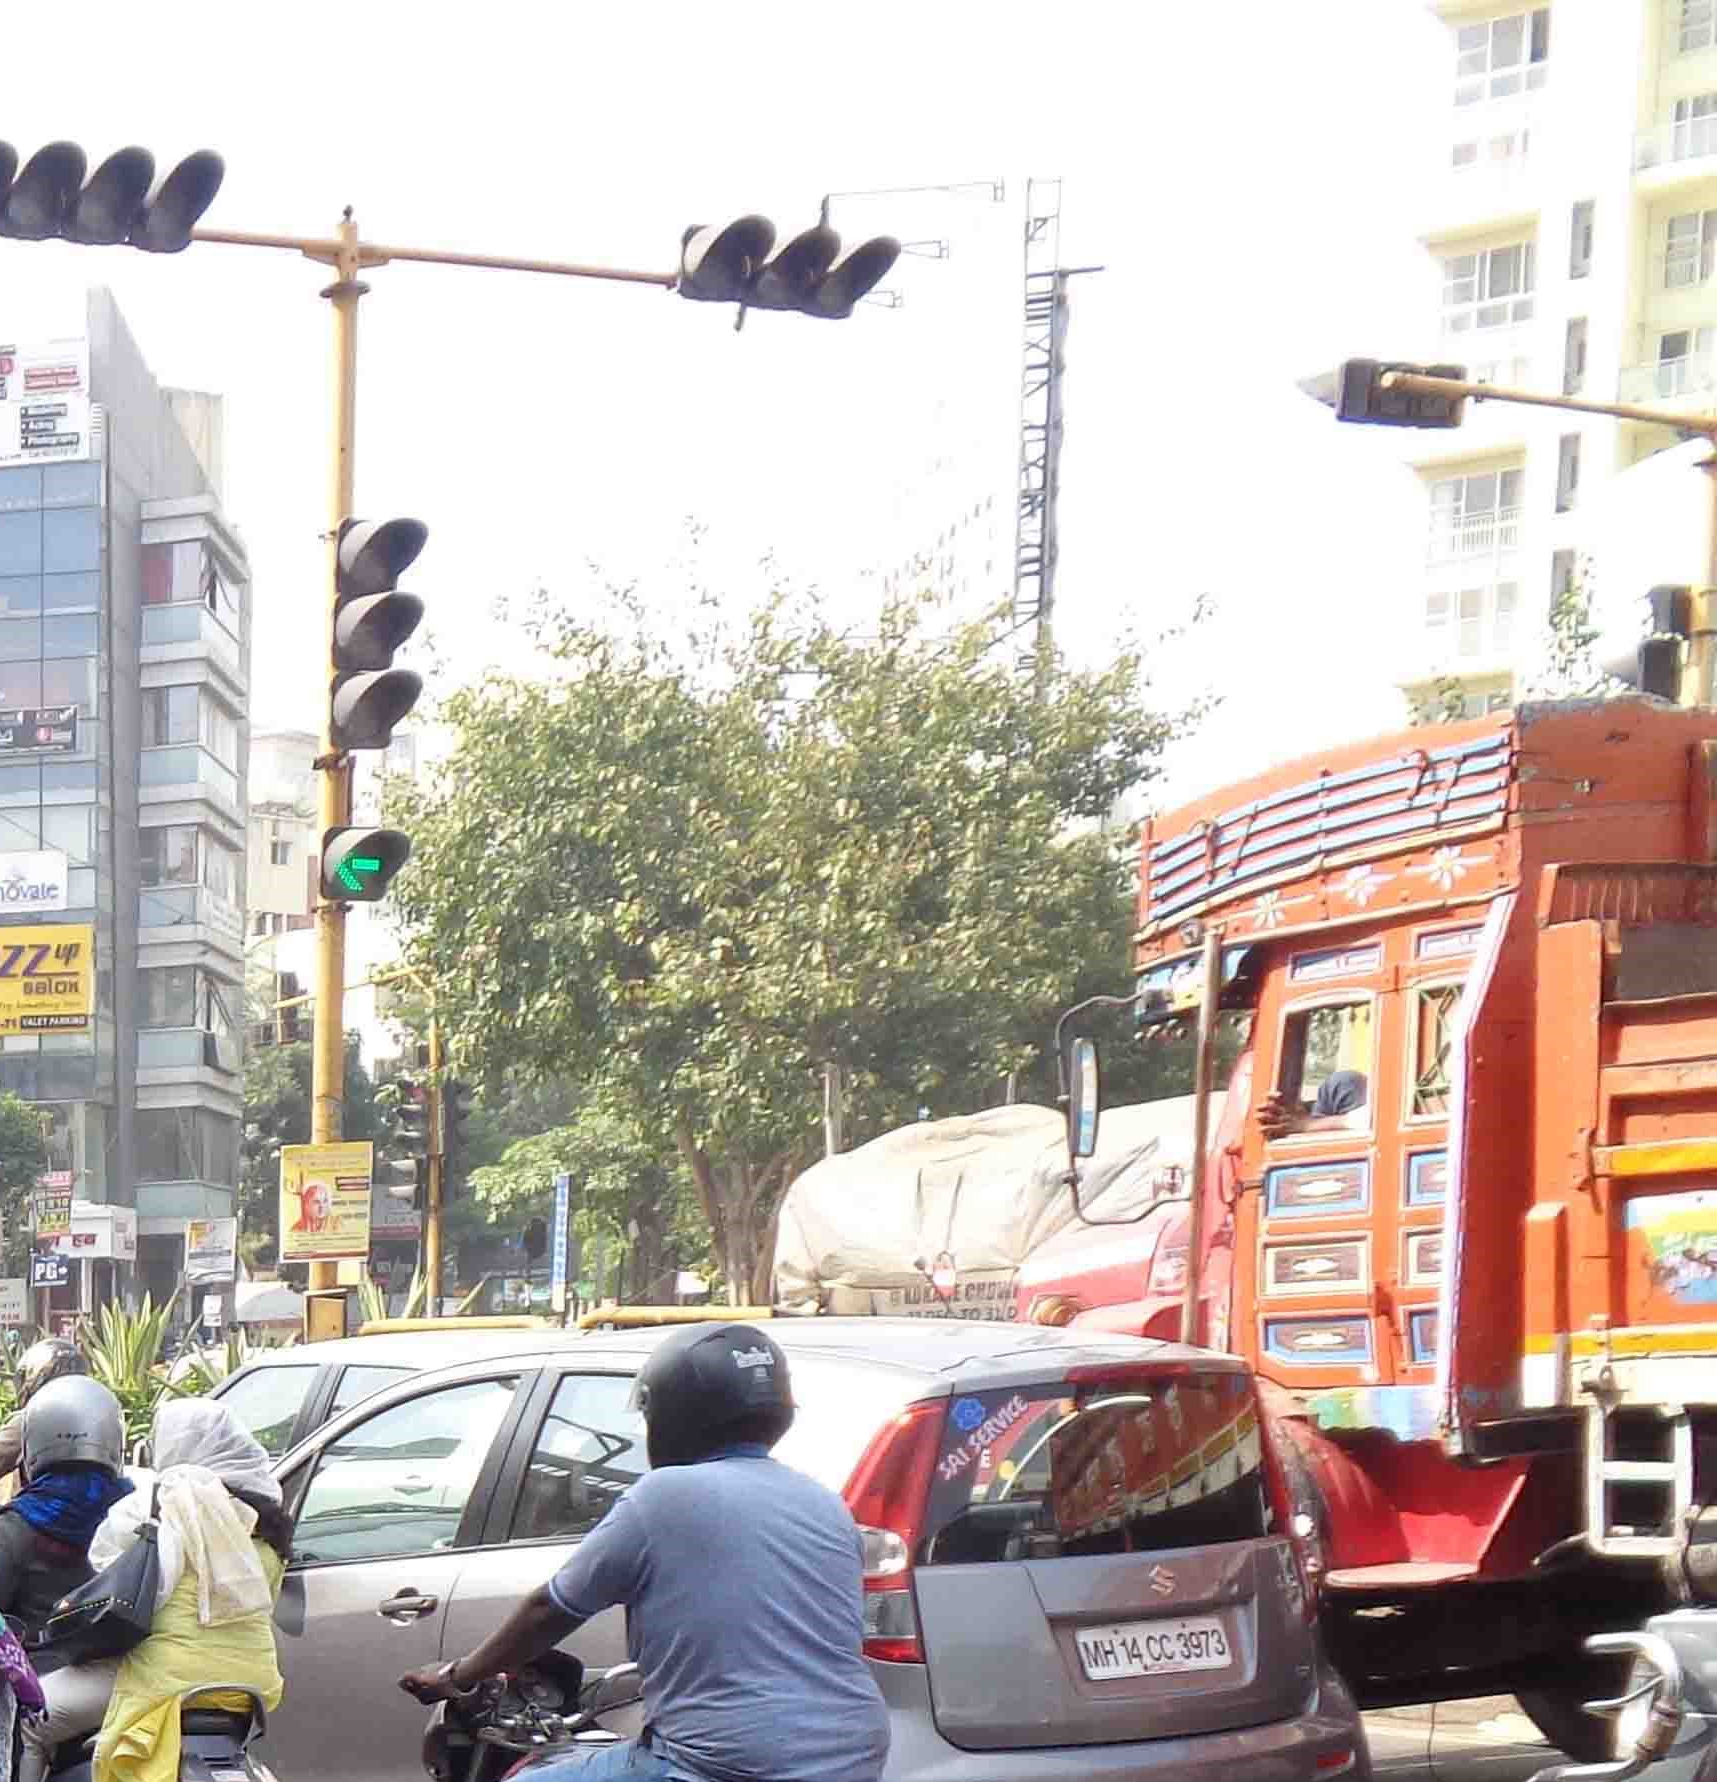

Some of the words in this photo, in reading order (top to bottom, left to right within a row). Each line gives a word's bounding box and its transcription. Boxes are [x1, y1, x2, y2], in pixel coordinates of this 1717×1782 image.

[35, 1263, 58, 1281] PG
[938, 1446, 973, 1481] SAI
[967, 1394, 1030, 1455] SERVICE
[1081, 1638, 1119, 1669] MH
[1121, 1636, 1144, 1665] 14
[1145, 1633, 1176, 1662] CC
[1176, 1628, 1227, 1660] 3973
